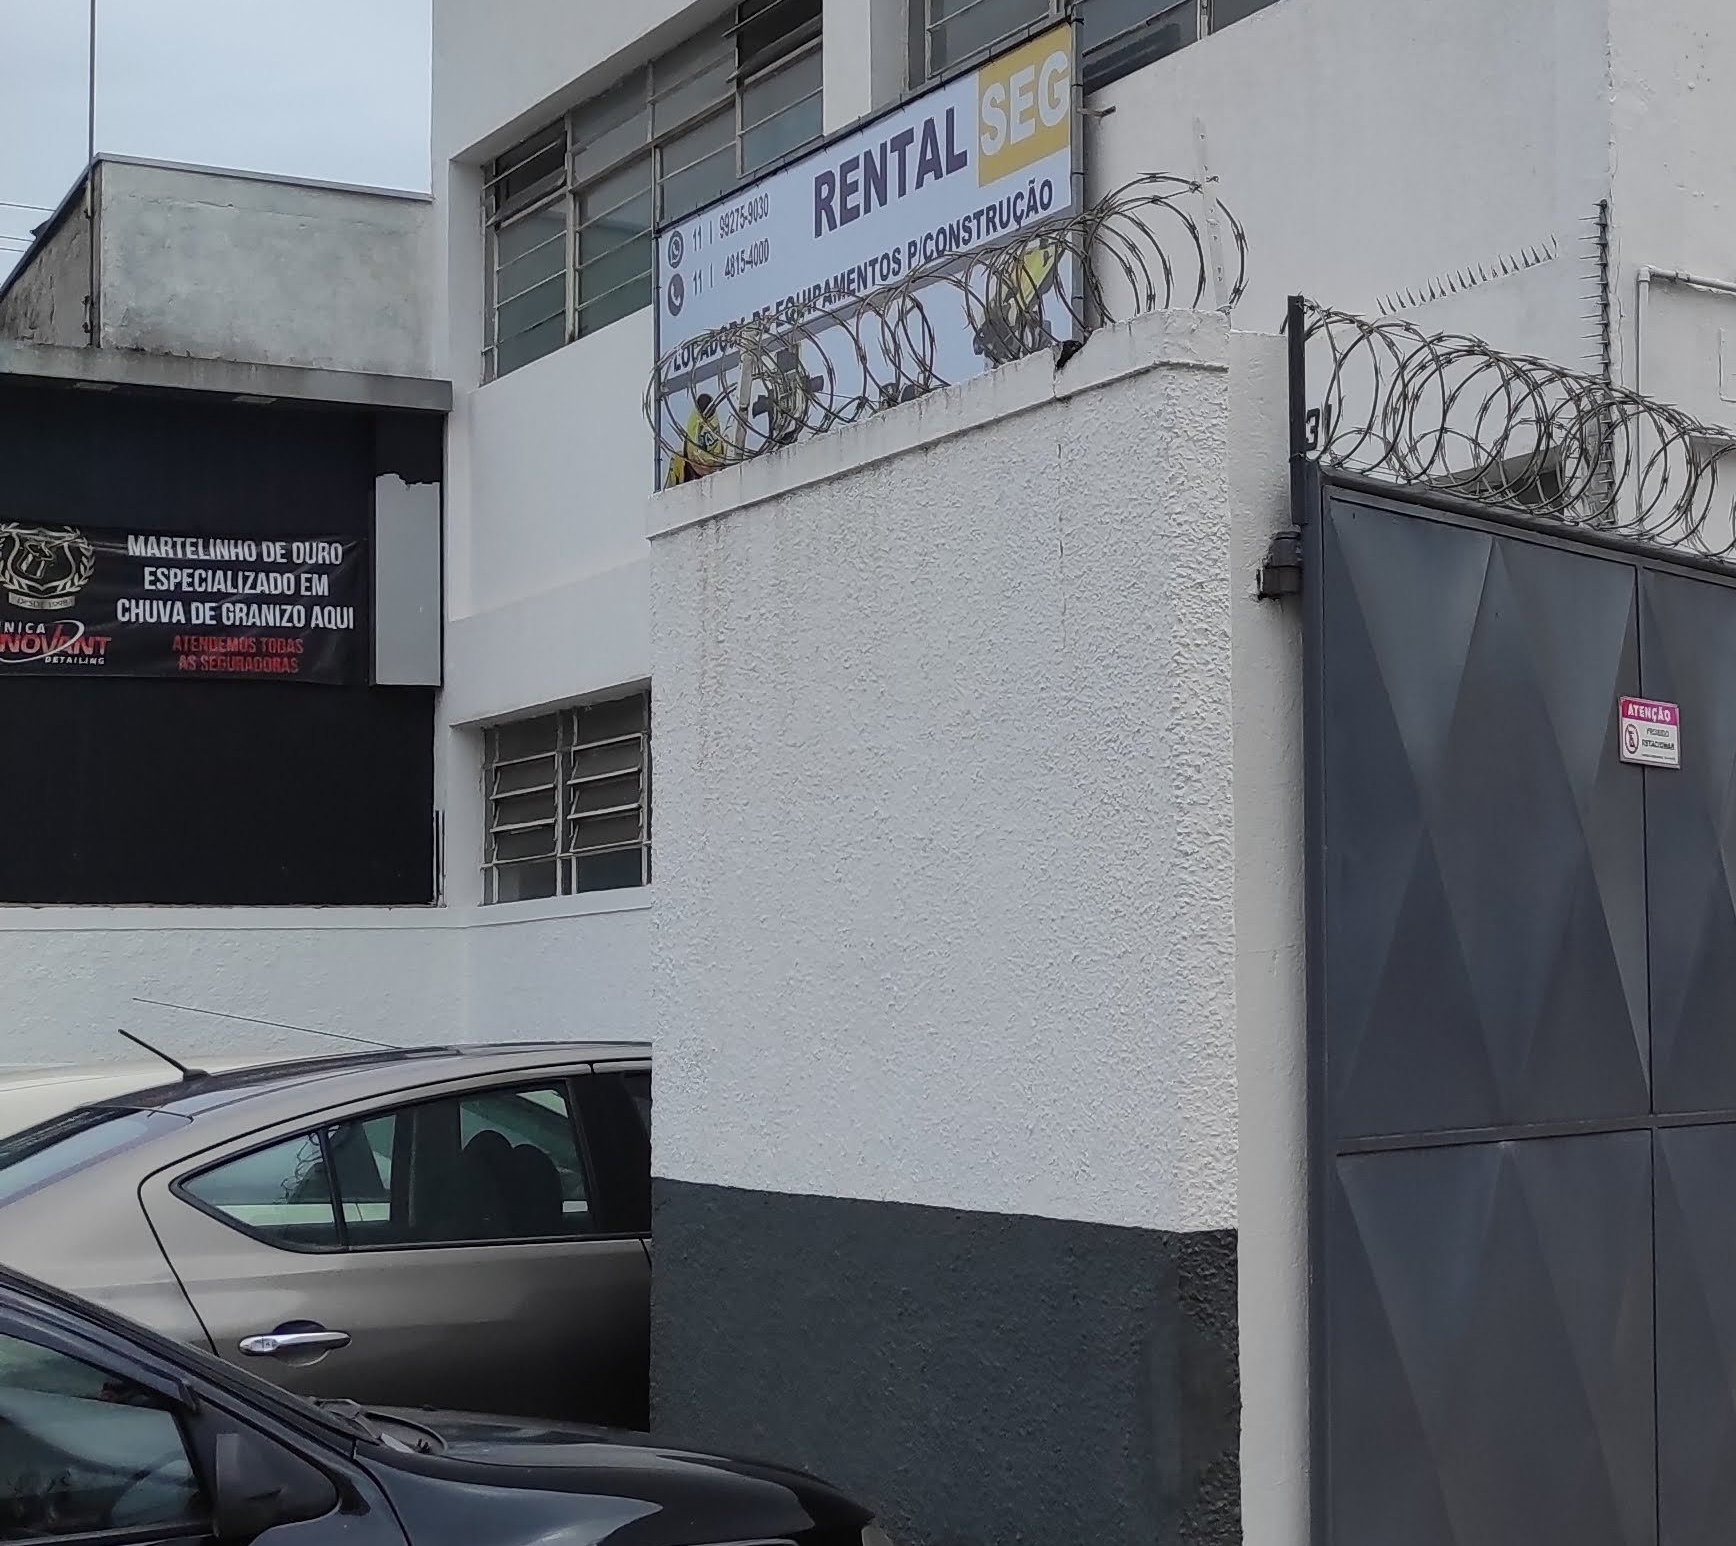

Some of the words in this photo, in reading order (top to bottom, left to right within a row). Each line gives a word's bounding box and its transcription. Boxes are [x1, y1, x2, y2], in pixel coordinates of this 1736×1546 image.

[814, 107, 968, 238] RENTAL
[980, 50, 1069, 157] SEG
[693, 224, 702, 252] 11
[693, 269, 703, 295] 11
[724, 238, 770, 279] 4815-4000
[127, 534, 257, 562] MARTELINHO
[262, 540, 287, 563] DE
[292, 541, 343, 565] OURO
[143, 566, 295, 596] ESPECIALIZADO
[300, 573, 329, 596] EM
[0, 620, 46, 634] NICA
[116, 598, 186, 625] CHUVA
[190, 602, 218, 625] DE
[221, 603, 306, 629] GRANIZO
[310, 605, 354, 630] AQUI
[172, 635, 257, 653] ATENDEMOS
[260, 637, 304, 654] TODAS
[44, 656, 105, 665] DETAILING
[178, 655, 197, 671] AS
[200, 655, 299, 674] SEGURADORAS
[1627, 703, 1671, 723] ATENÇÃO
